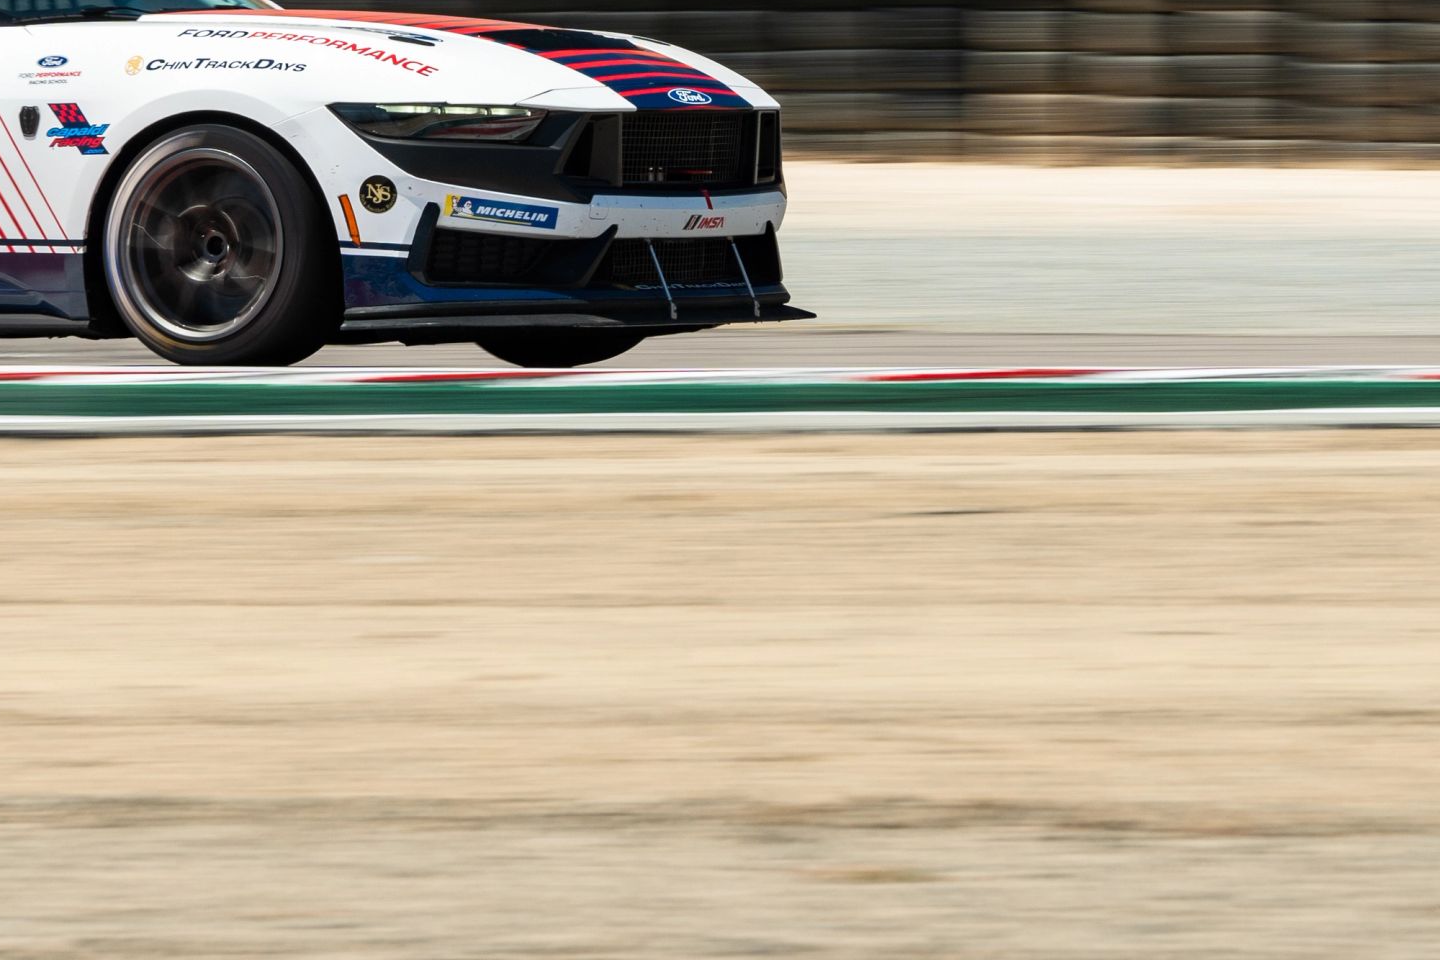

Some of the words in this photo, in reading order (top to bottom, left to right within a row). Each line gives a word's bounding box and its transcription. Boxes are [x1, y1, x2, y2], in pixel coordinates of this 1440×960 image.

[46, 123, 109, 138] capaldi
[49, 136, 105, 148] racing
[366, 183, 391, 204] NJS
[475, 205, 549, 222] MICHELIN
[696, 216, 724, 230] IMSA
